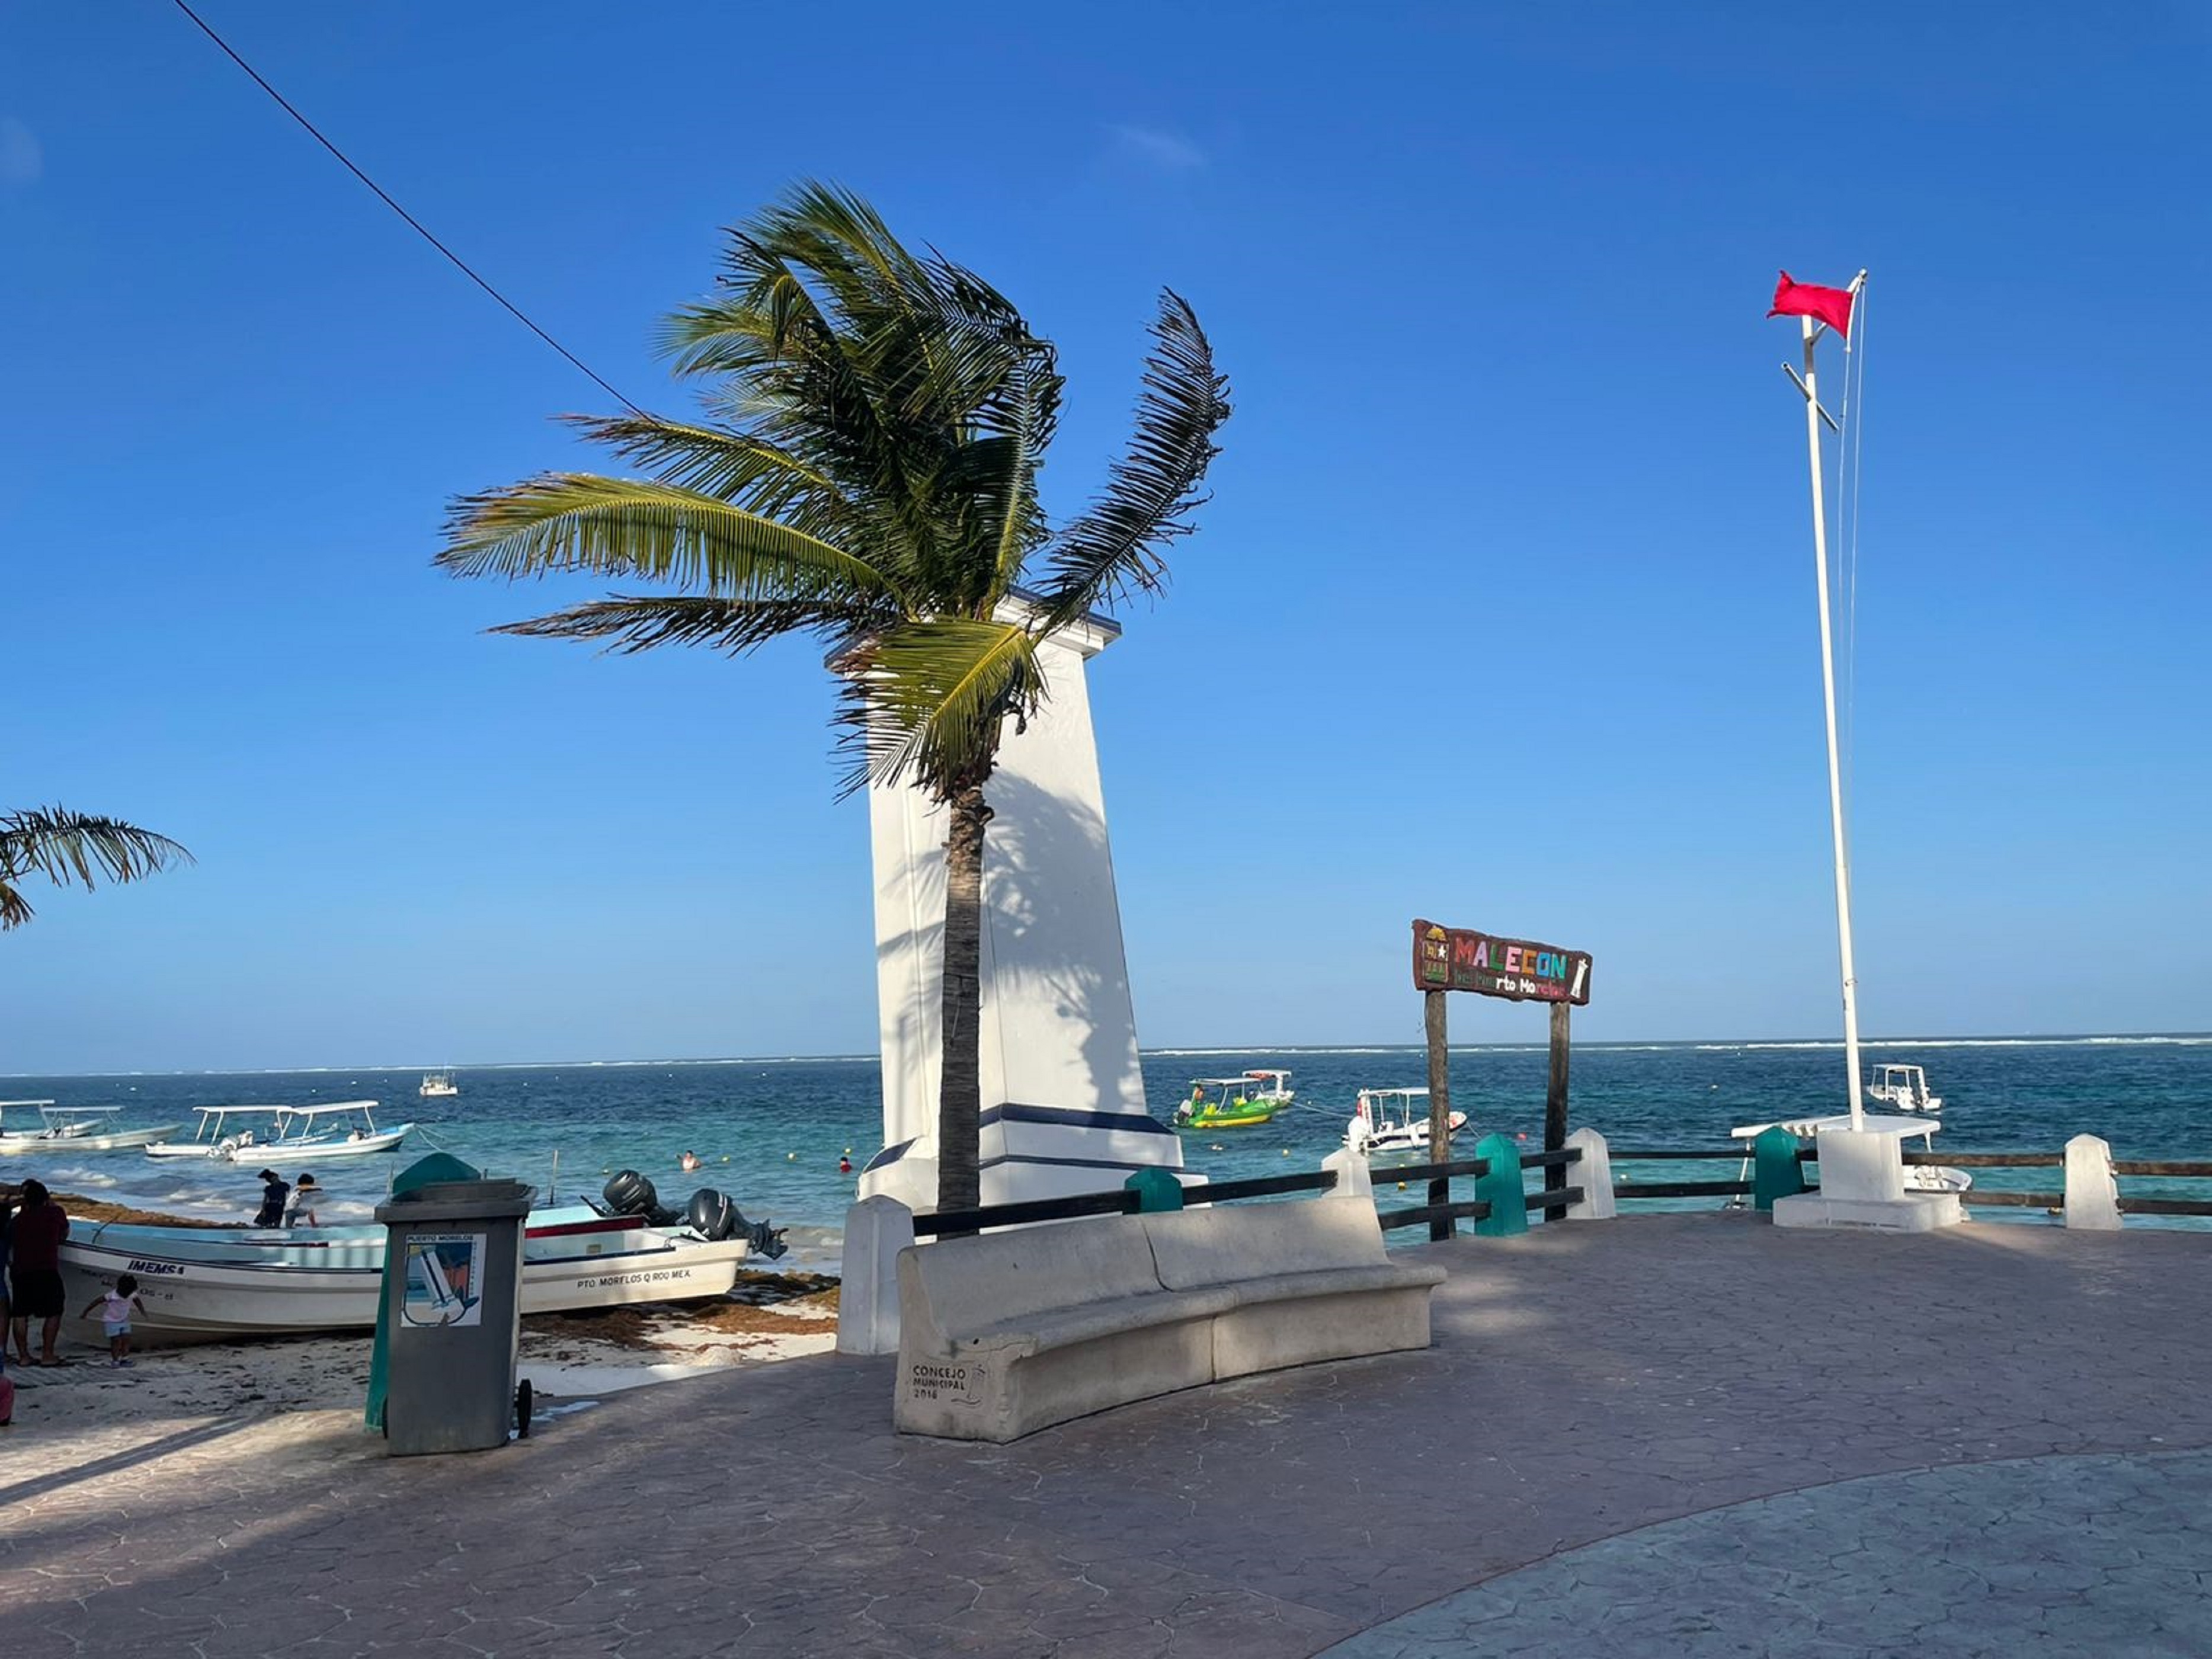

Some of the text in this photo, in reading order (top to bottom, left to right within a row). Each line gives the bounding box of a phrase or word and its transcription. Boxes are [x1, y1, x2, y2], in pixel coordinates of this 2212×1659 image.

[1455, 937, 1567, 980] MALECON
[577, 1280, 596, 1288] PTO
[599, 1274, 642, 1286] MORELOS
[913, 1365, 966, 1379] CONCEJO
[913, 1378, 965, 1391] MUNICIPAL
[914, 1389, 937, 1399] 2016
